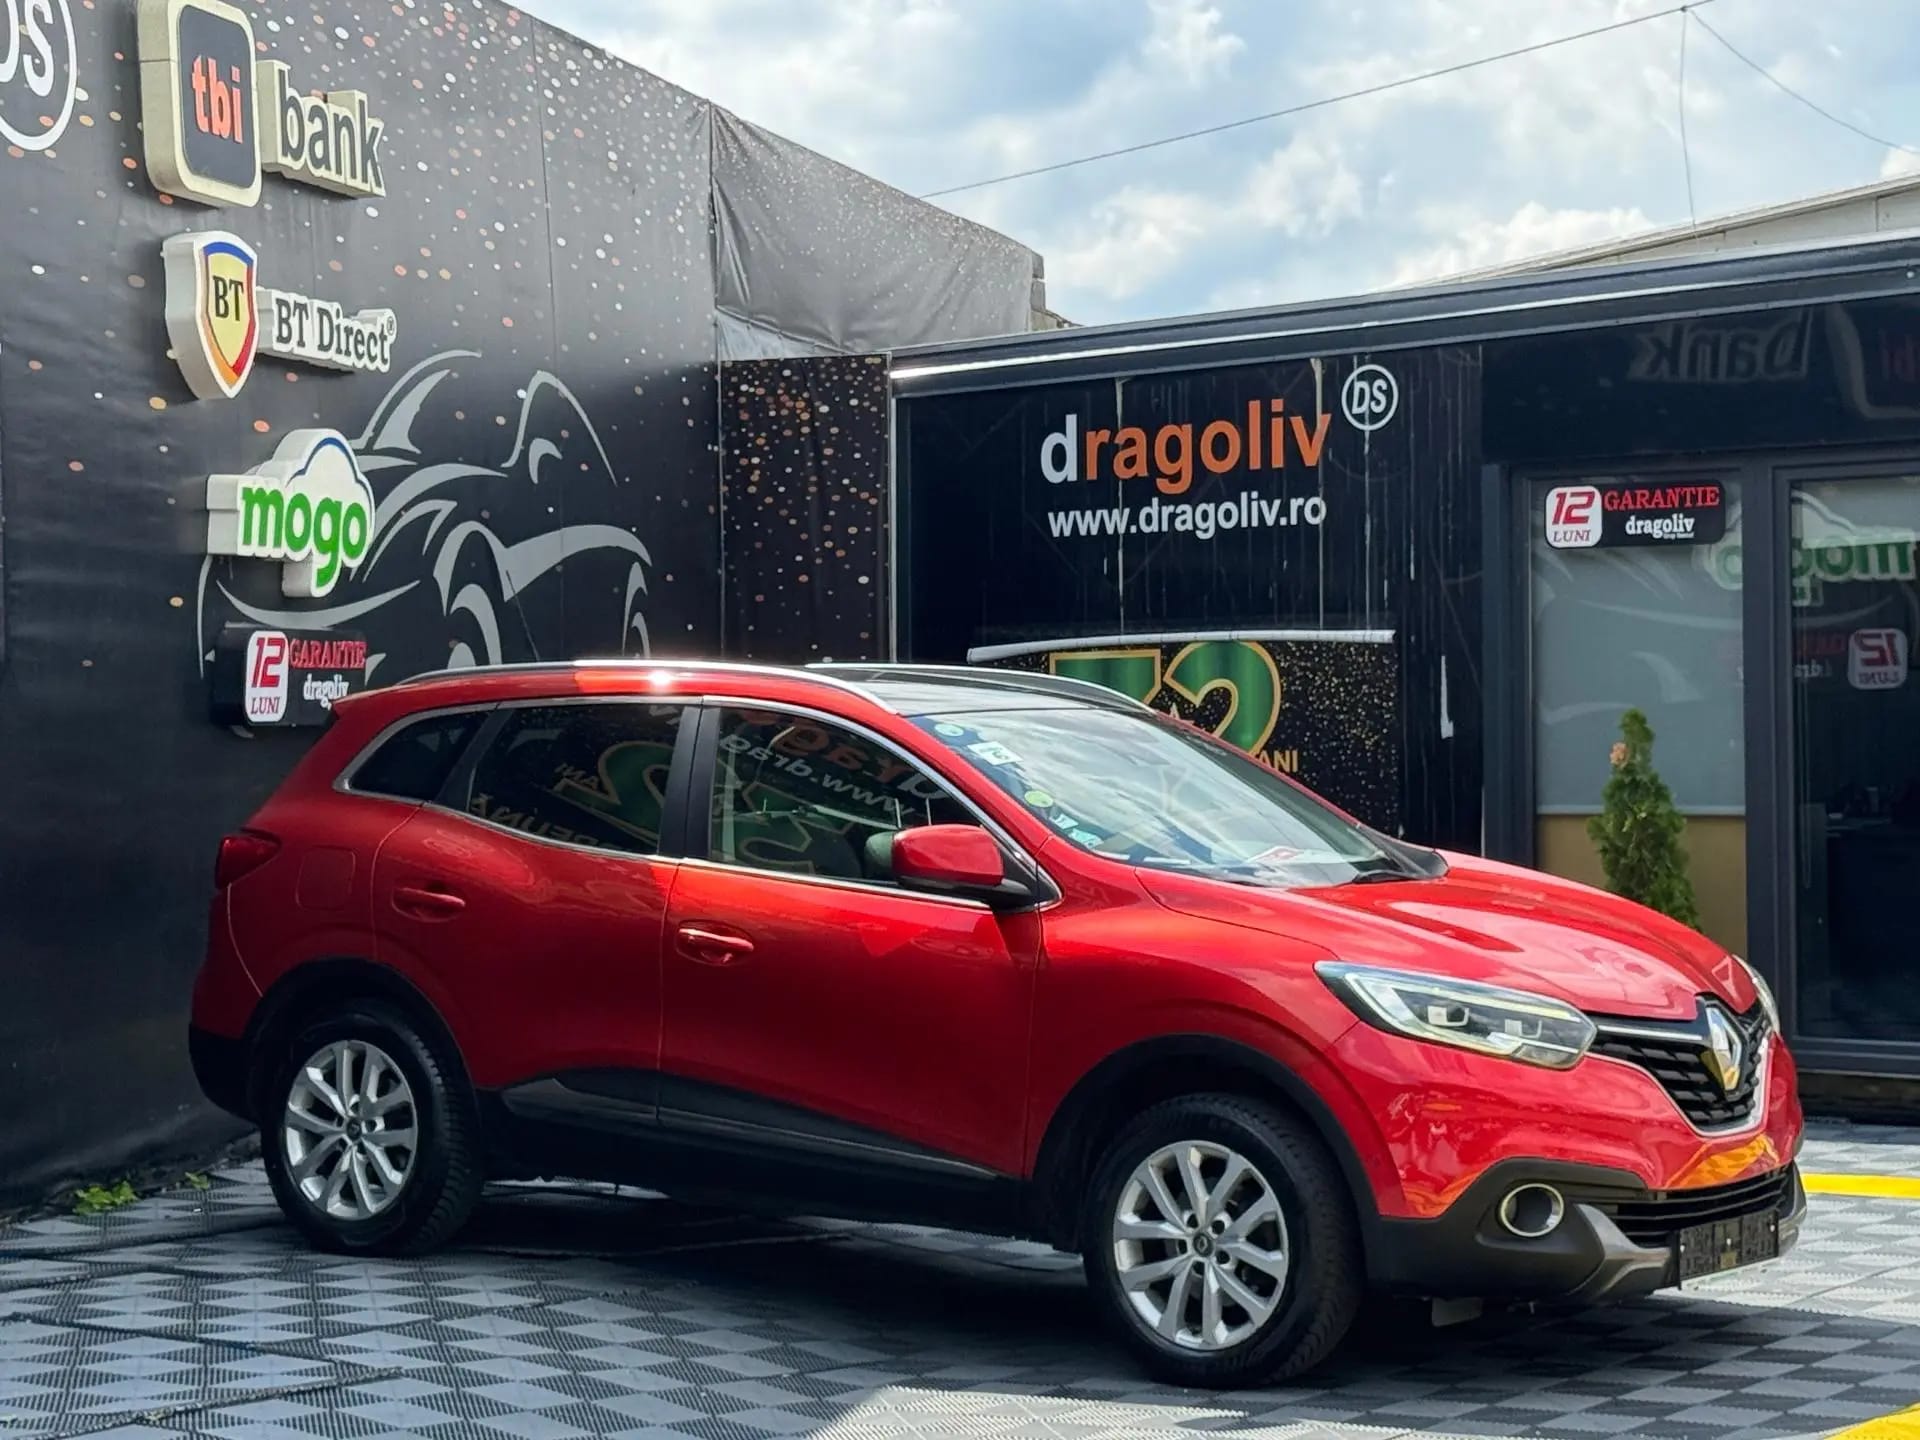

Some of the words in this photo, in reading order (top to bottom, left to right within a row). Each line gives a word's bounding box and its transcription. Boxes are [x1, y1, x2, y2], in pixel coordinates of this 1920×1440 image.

[191, 55, 244, 144] tbi
[278, 69, 383, 189] bank
[213, 275, 245, 322] BT
[274, 298, 309, 348] BT
[1352, 379, 1388, 415] DS
[1040, 398, 1332, 495] dragoliv
[1048, 491, 1327, 541] www.dragoliv.ro
[1552, 491, 1596, 526] 12
[1603, 486, 1720, 511] GARANTIE
[241, 485, 367, 588] mogo
[1553, 529, 1592, 543] LUNI
[1625, 513, 1695, 539] dragoliv
[251, 637, 286, 688] 12
[290, 638, 367, 669] GARANTIE
[251, 696, 280, 715] LUNI
[304, 673, 350, 709] dragoliv
